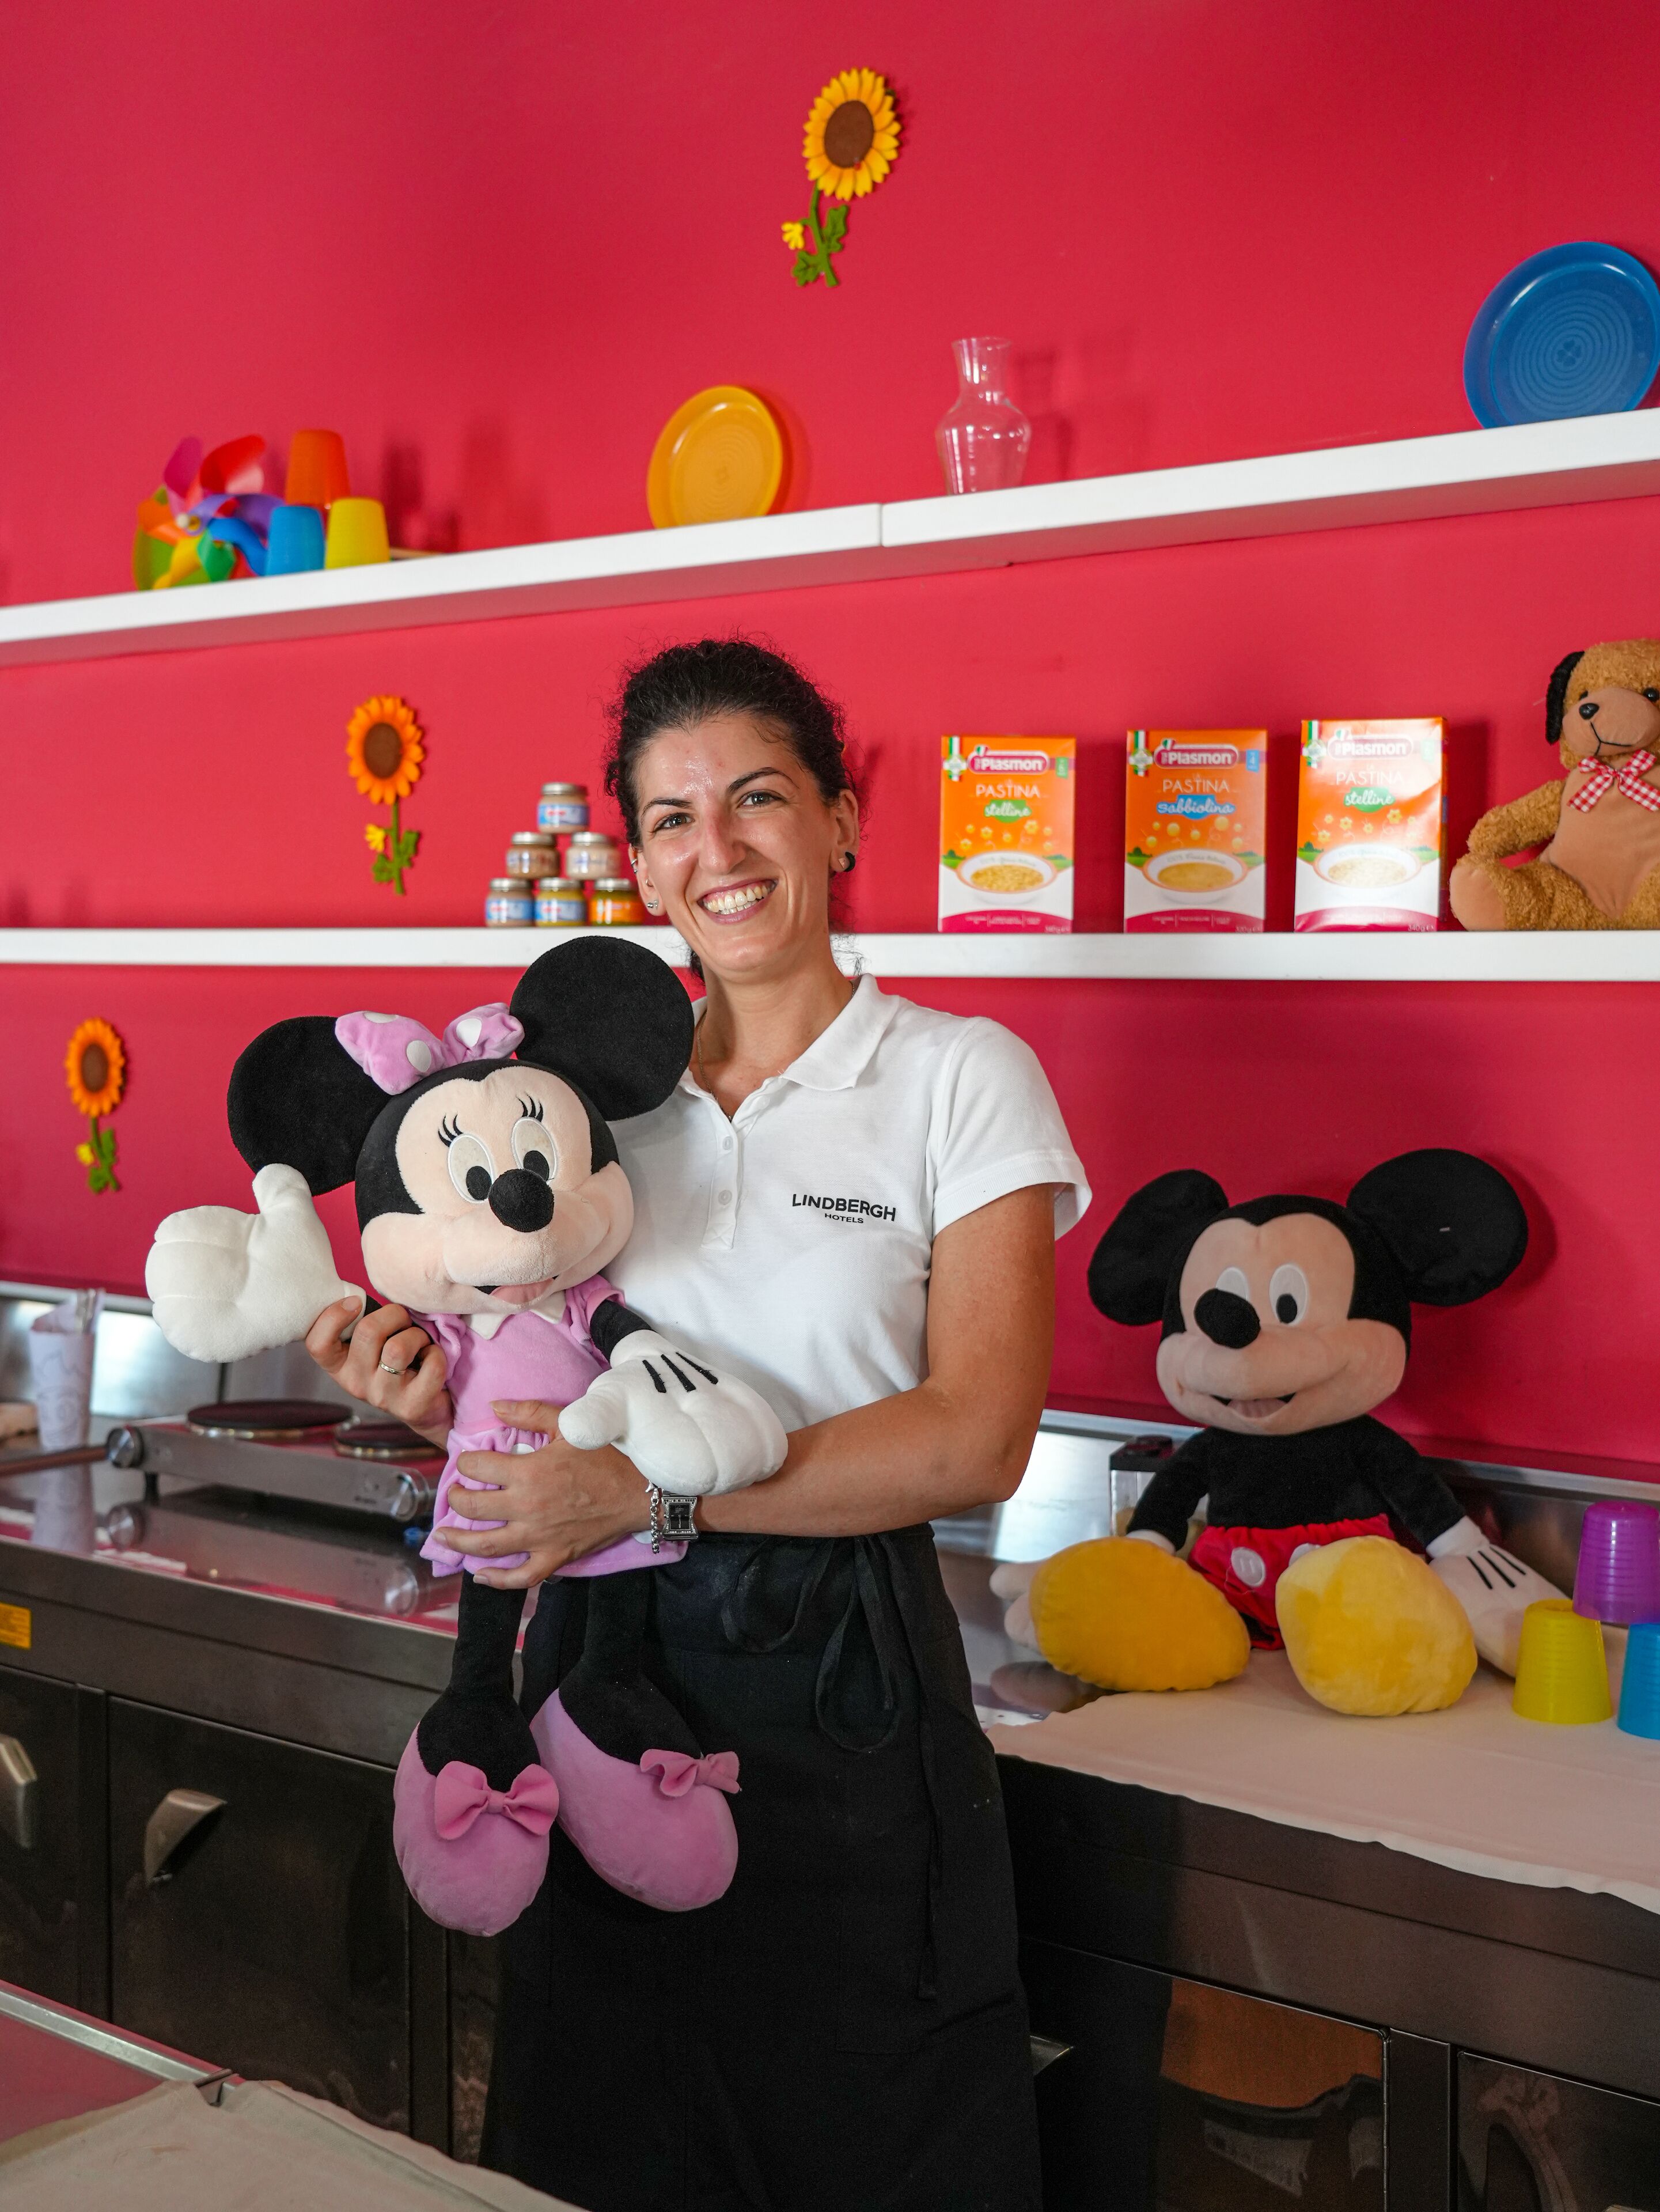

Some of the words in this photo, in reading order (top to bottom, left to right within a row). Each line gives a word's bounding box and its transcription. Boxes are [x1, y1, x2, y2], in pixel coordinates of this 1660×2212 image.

[1341, 742, 1405, 756] Plasmon
[981, 757, 1043, 771] Plasmon
[1168, 752, 1231, 765] Plasmon
[1336, 770, 1405, 786] PASTINA
[976, 783, 1041, 798] PASTINA
[1162, 779, 1230, 793] PASTINA
[1344, 789, 1394, 806] stelline
[984, 801, 1032, 817] stelline
[1157, 798, 1235, 814] sabbiolina
[792, 1194, 896, 1221] LINDBERGH
[824, 1213, 864, 1224] HOTELS
